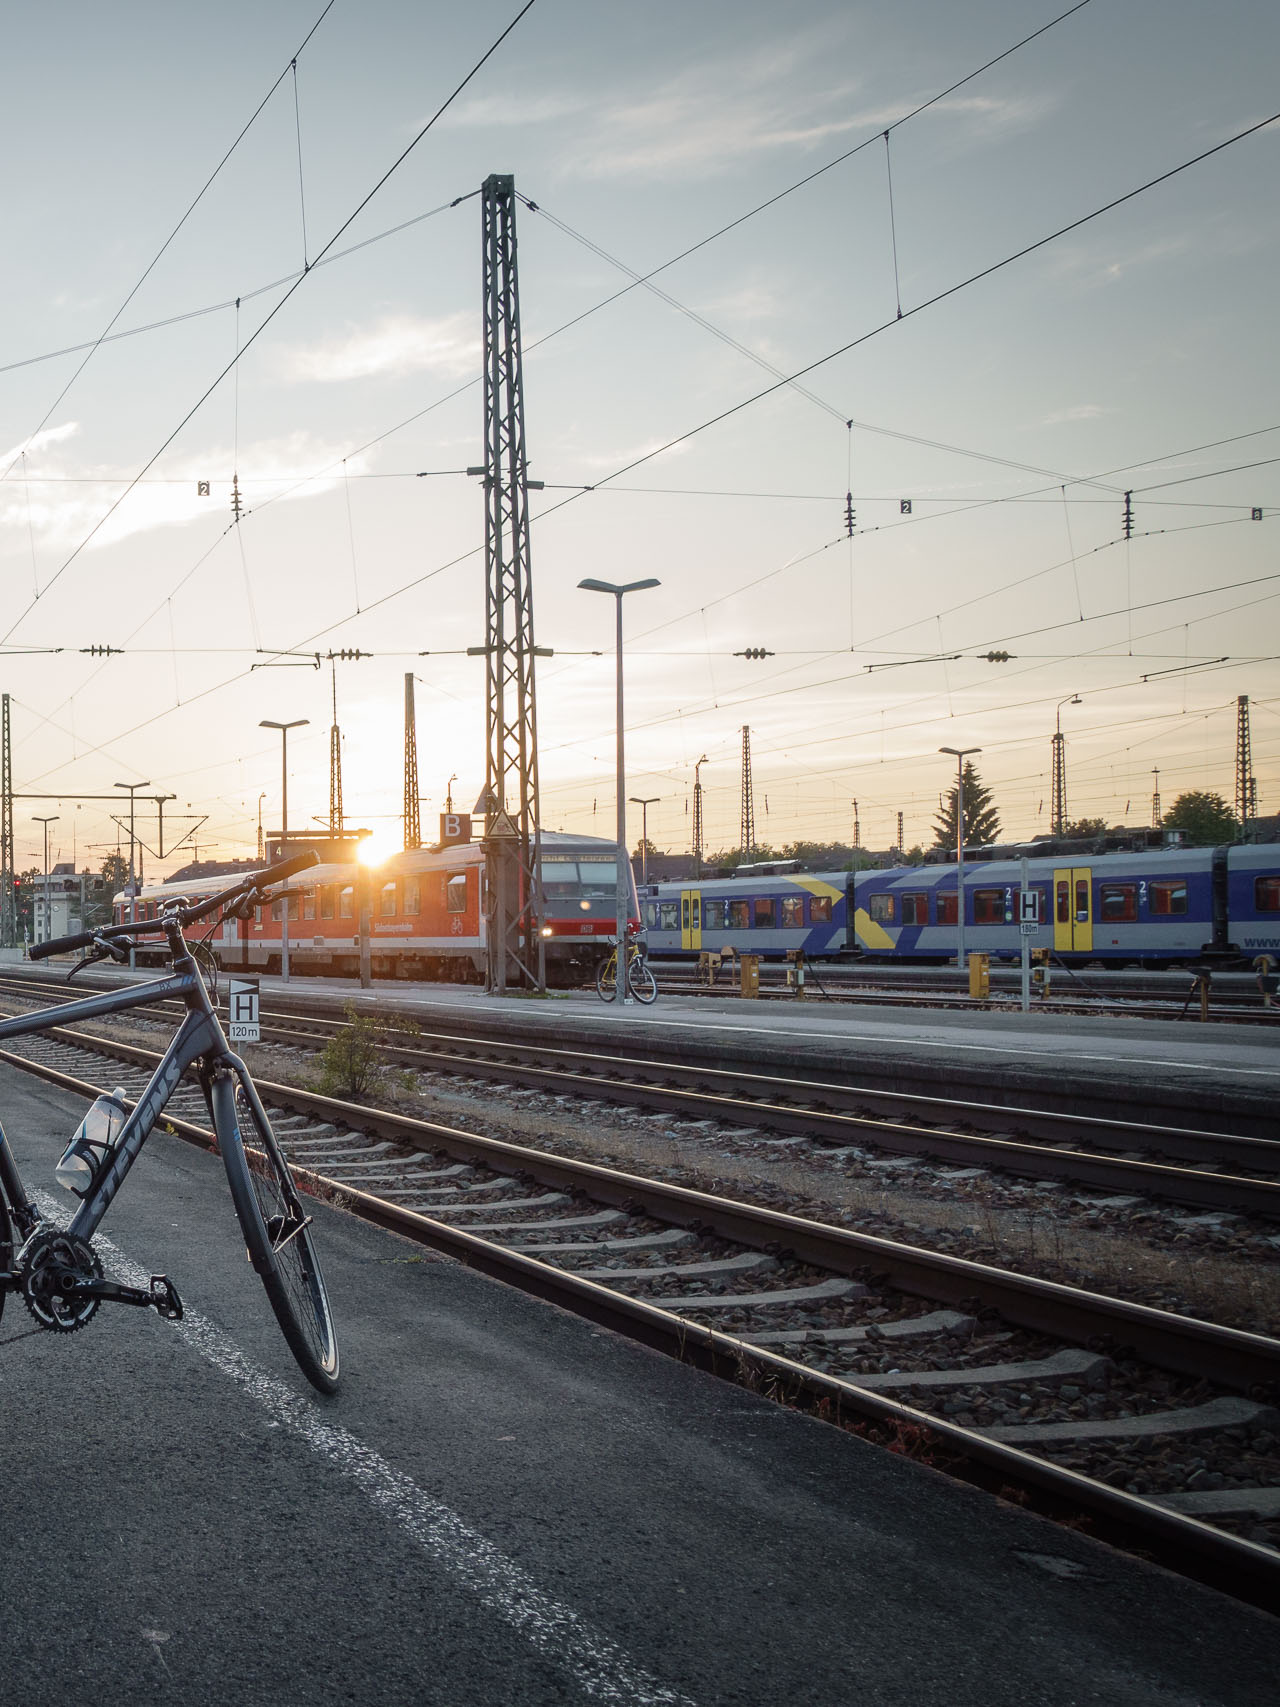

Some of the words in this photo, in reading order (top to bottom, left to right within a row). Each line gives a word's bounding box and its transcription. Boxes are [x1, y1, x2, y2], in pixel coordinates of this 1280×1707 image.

[445, 815, 461, 837] B
[276, 846, 282, 856] 4
[1005, 887, 1012, 898] 2
[1139, 880, 1147, 893] 2
[1022, 893, 1037, 919] H
[236, 995, 253, 1021] H
[91, 1057, 182, 1216] STEVENS
[75, 1278, 96, 1286] XT
